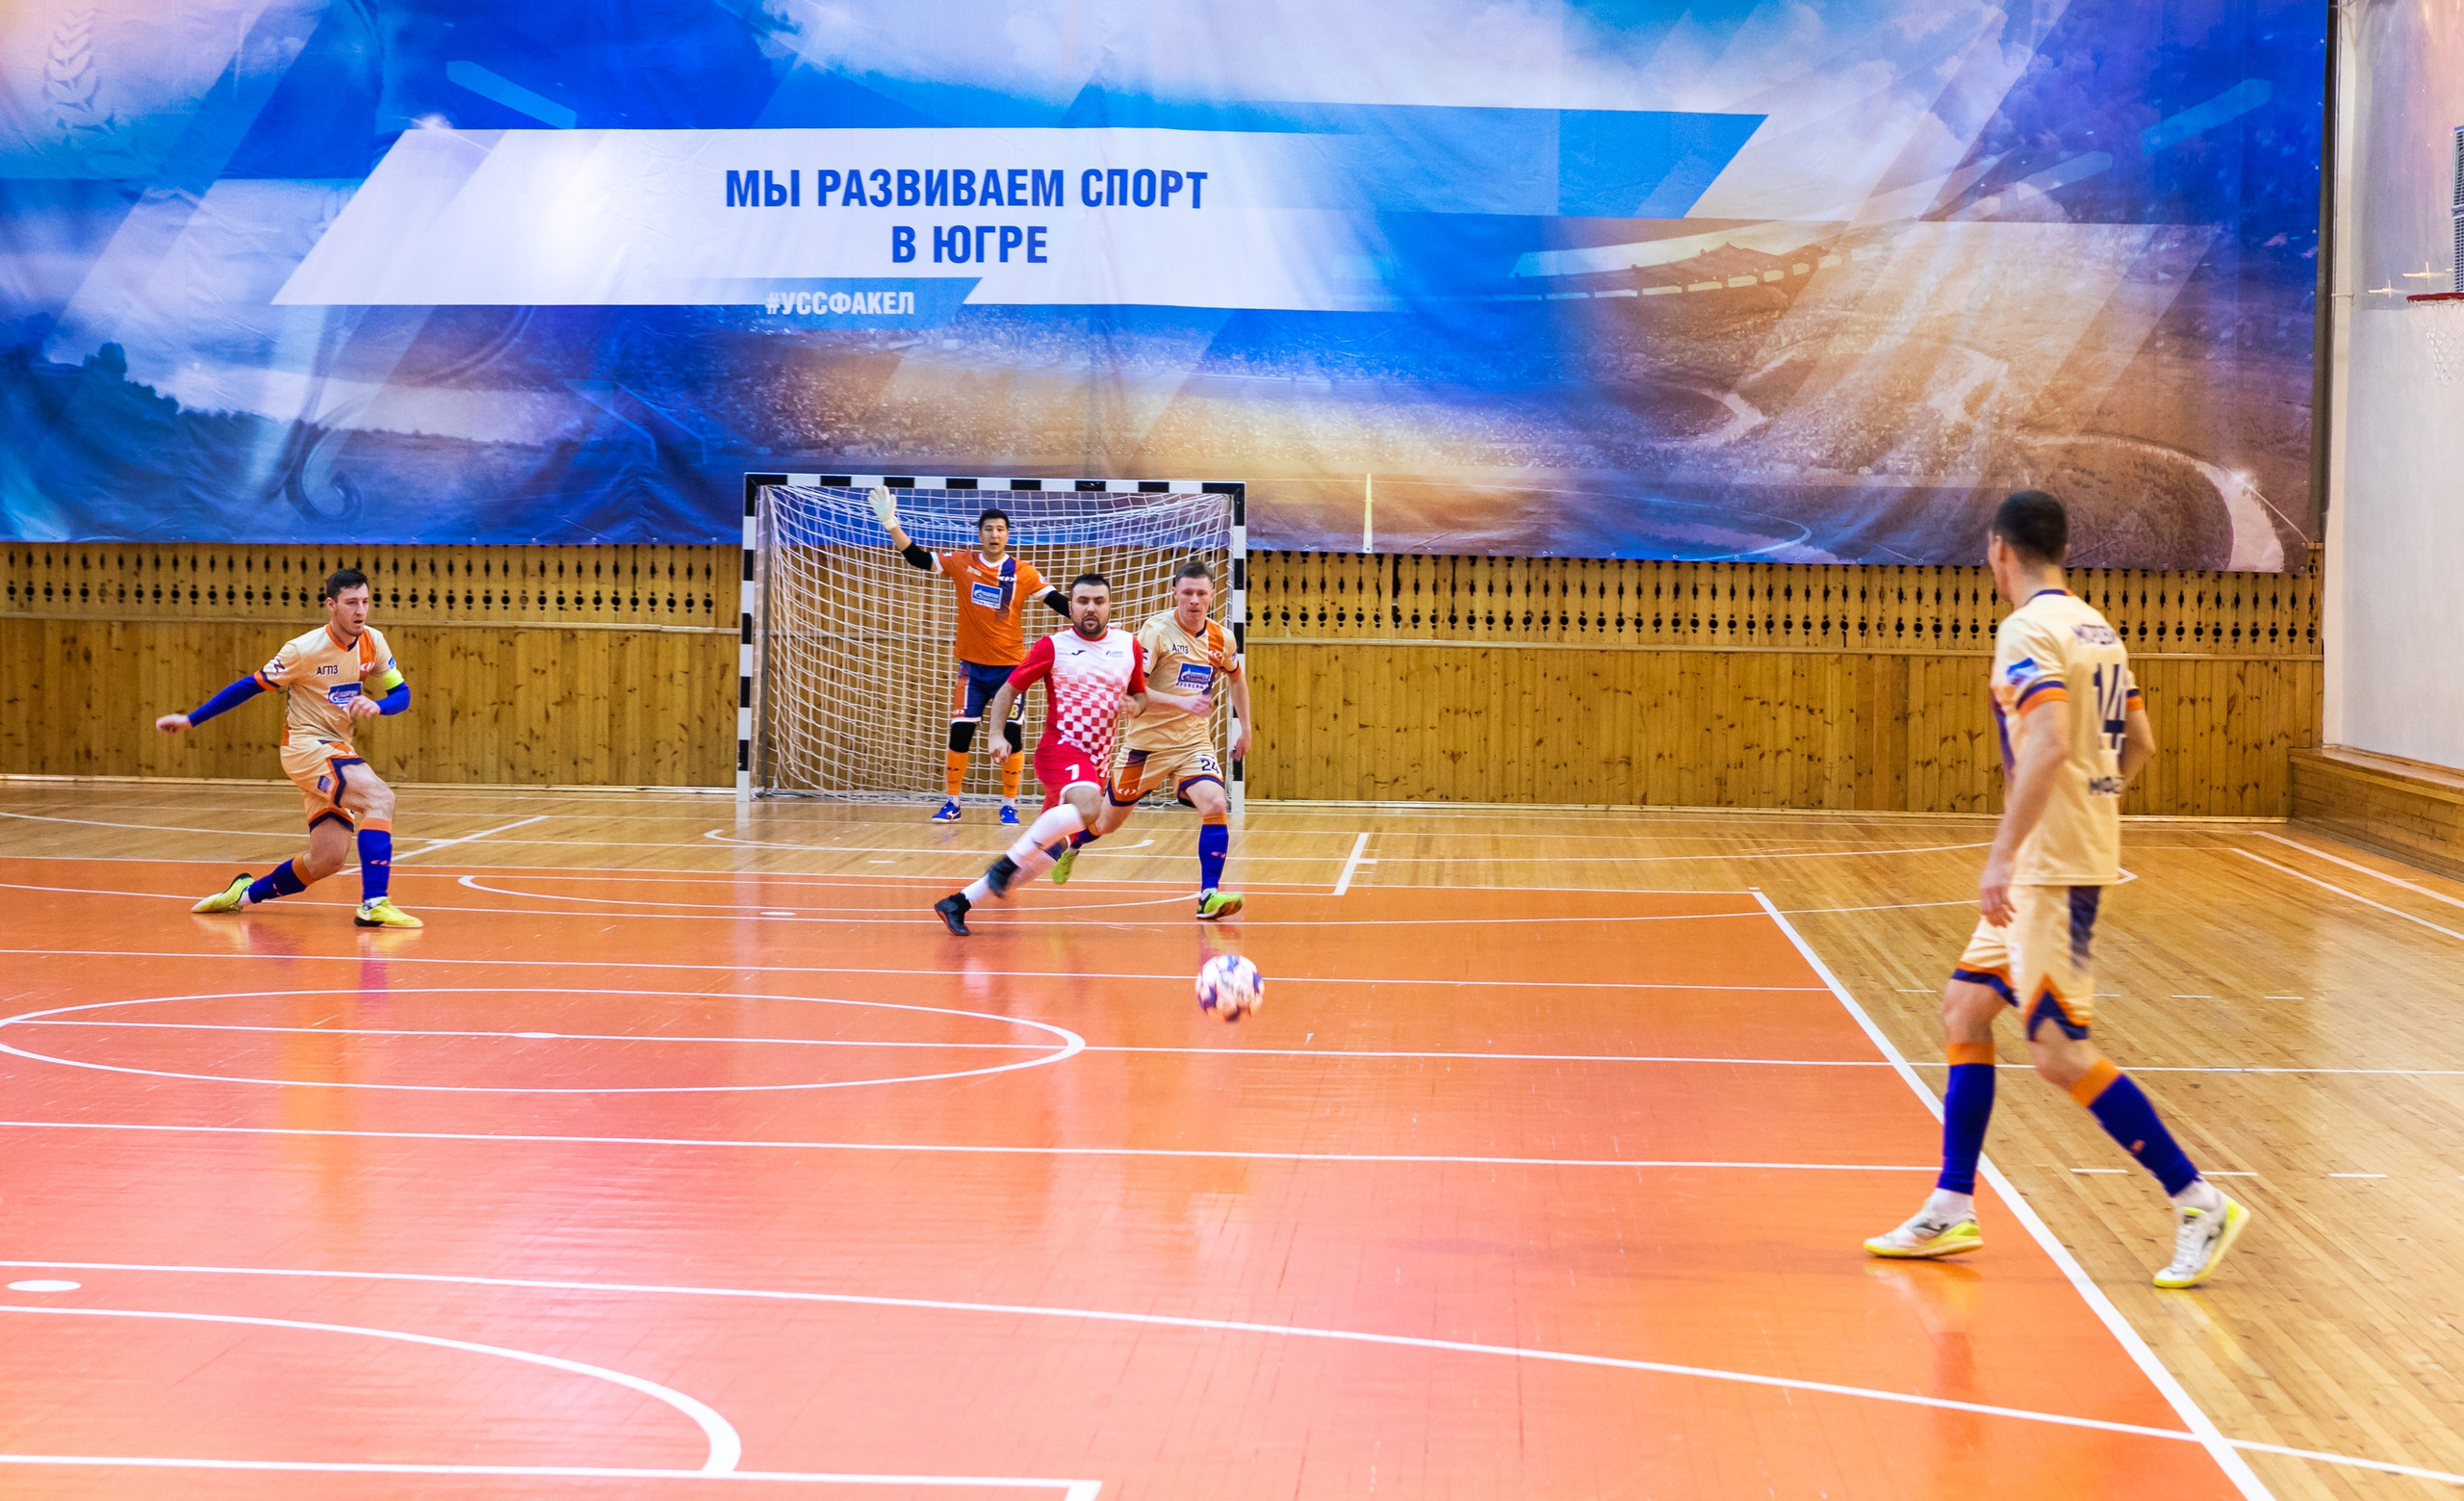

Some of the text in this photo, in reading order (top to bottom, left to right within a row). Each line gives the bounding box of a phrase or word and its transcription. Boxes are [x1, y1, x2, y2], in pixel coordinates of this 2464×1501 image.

[726, 168, 1208, 209] МЫ РАЗВИВАЕМ СПОРТ
[891, 224, 1049, 264] В ЮГРЕ
[765, 291, 914, 315] #УССФАКЕЛ
[316, 664, 339, 675] АГПЗ
[2092, 662, 2126, 750] 14
[1200, 758, 1219, 774] 24
